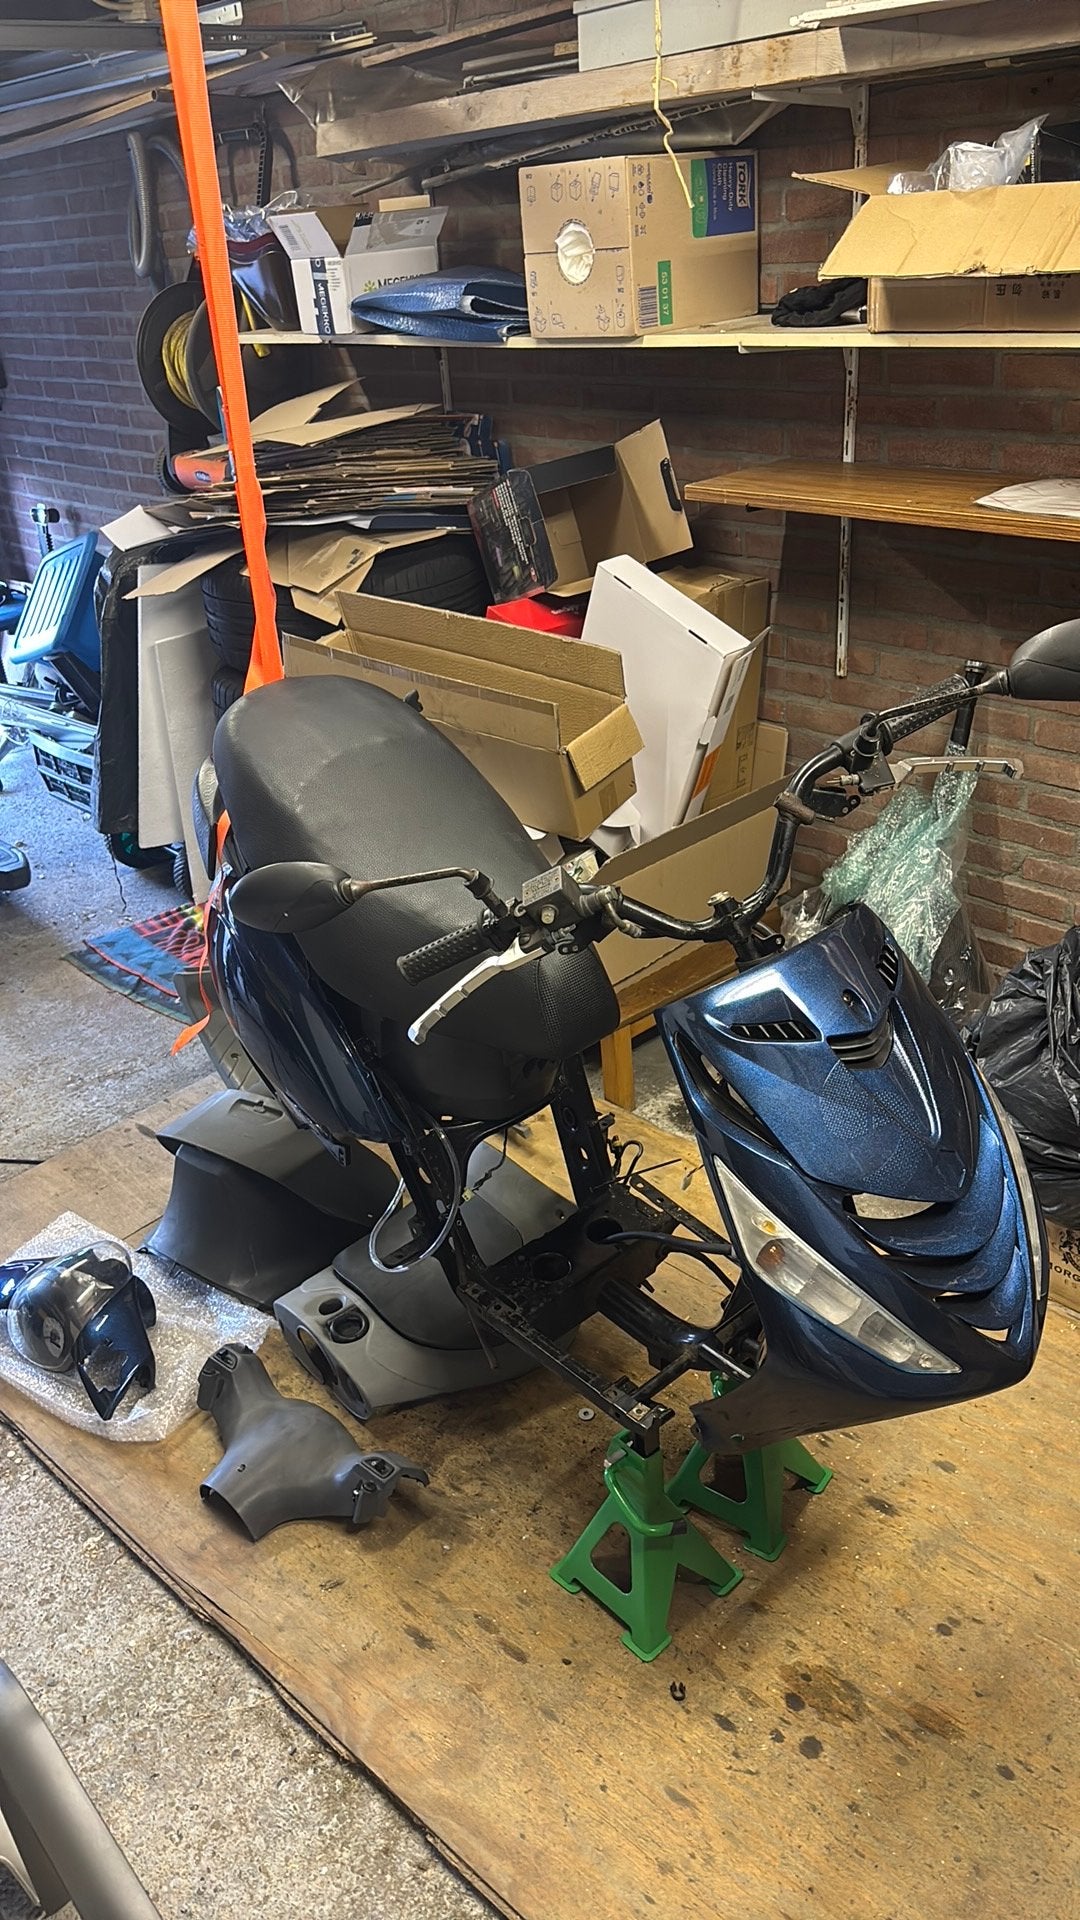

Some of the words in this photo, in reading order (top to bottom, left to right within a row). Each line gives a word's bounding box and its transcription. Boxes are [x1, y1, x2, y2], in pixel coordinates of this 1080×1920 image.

[738, 163, 747, 206] TORK
[662, 287, 669, 299] 01
[318, 282, 332, 335] MEGEKKO
[663, 303, 670, 316] 37
